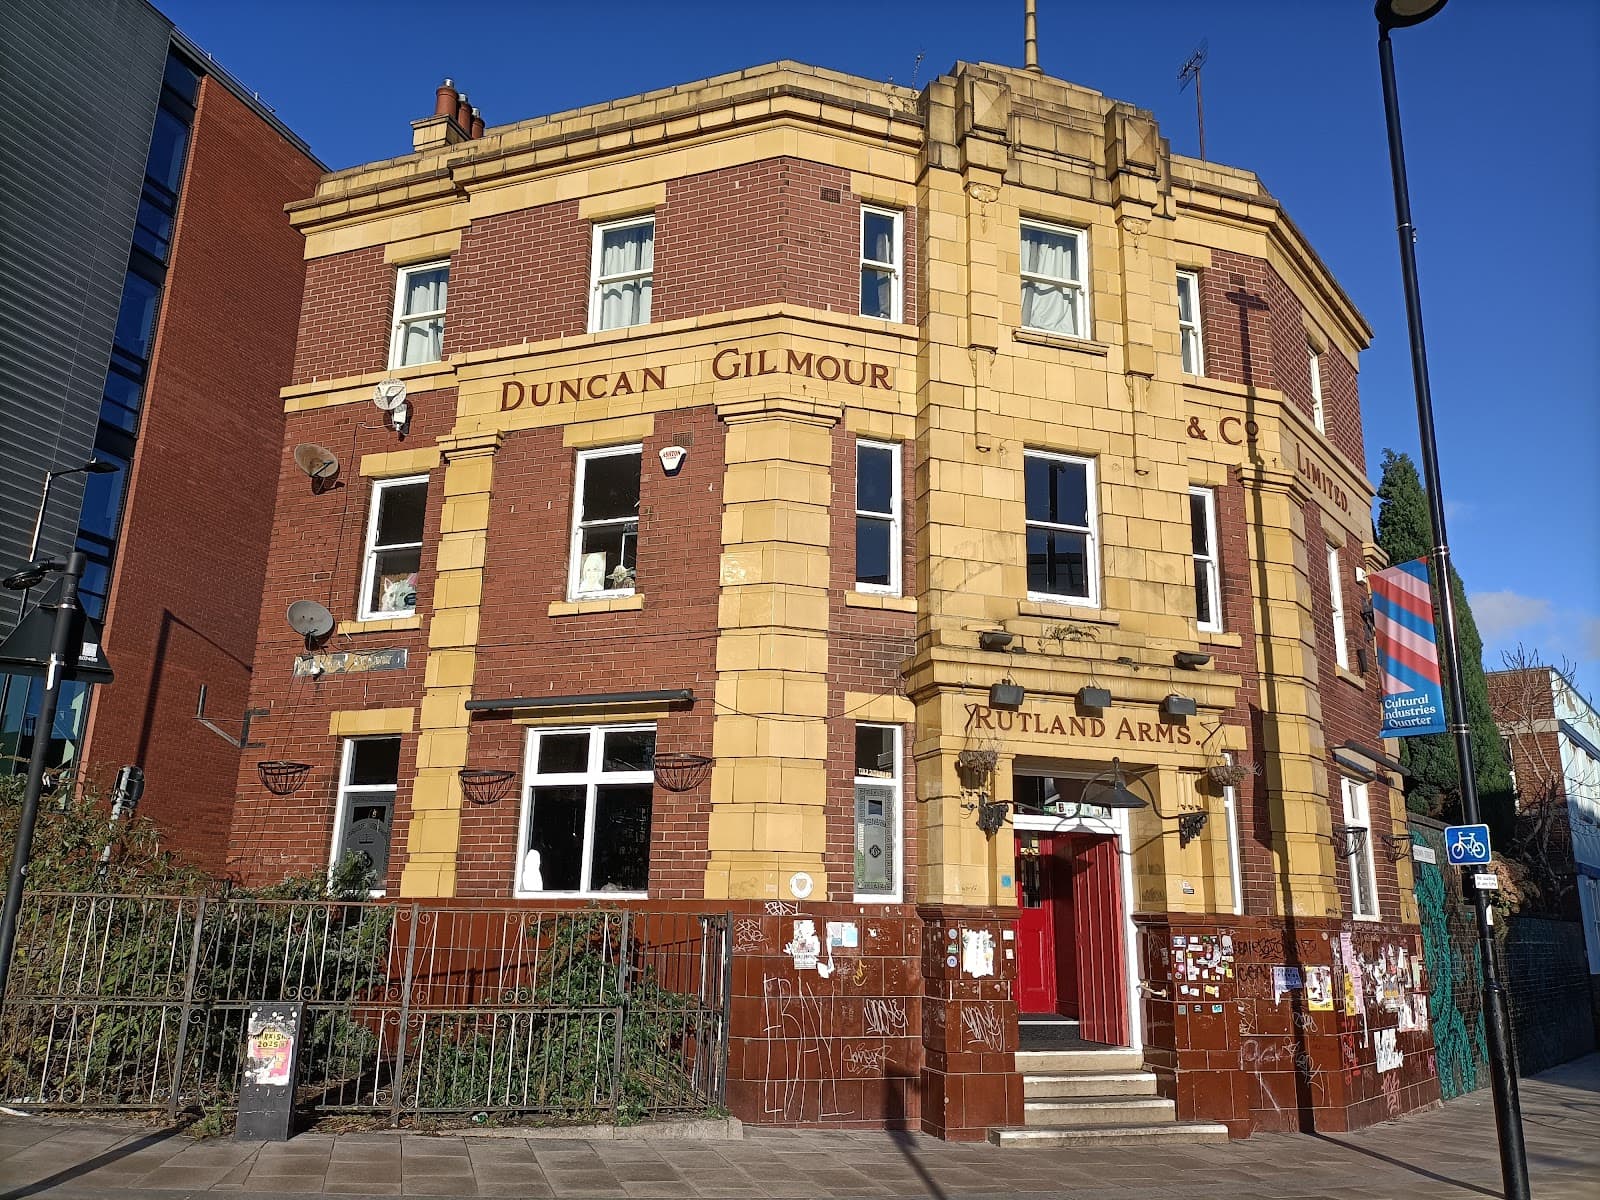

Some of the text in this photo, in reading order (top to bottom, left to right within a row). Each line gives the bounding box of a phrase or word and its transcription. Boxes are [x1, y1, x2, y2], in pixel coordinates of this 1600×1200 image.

[500, 365, 667, 411] DUNCAN
[712, 348, 893, 390] GILMOUR
[1186, 416, 1208, 440] &
[1385, 693, 1428, 709] Cultural
[1383, 705, 1436, 719] ndustries
[974, 704, 1105, 738] RUTLAND
[1389, 716, 1432, 728] Quarter
